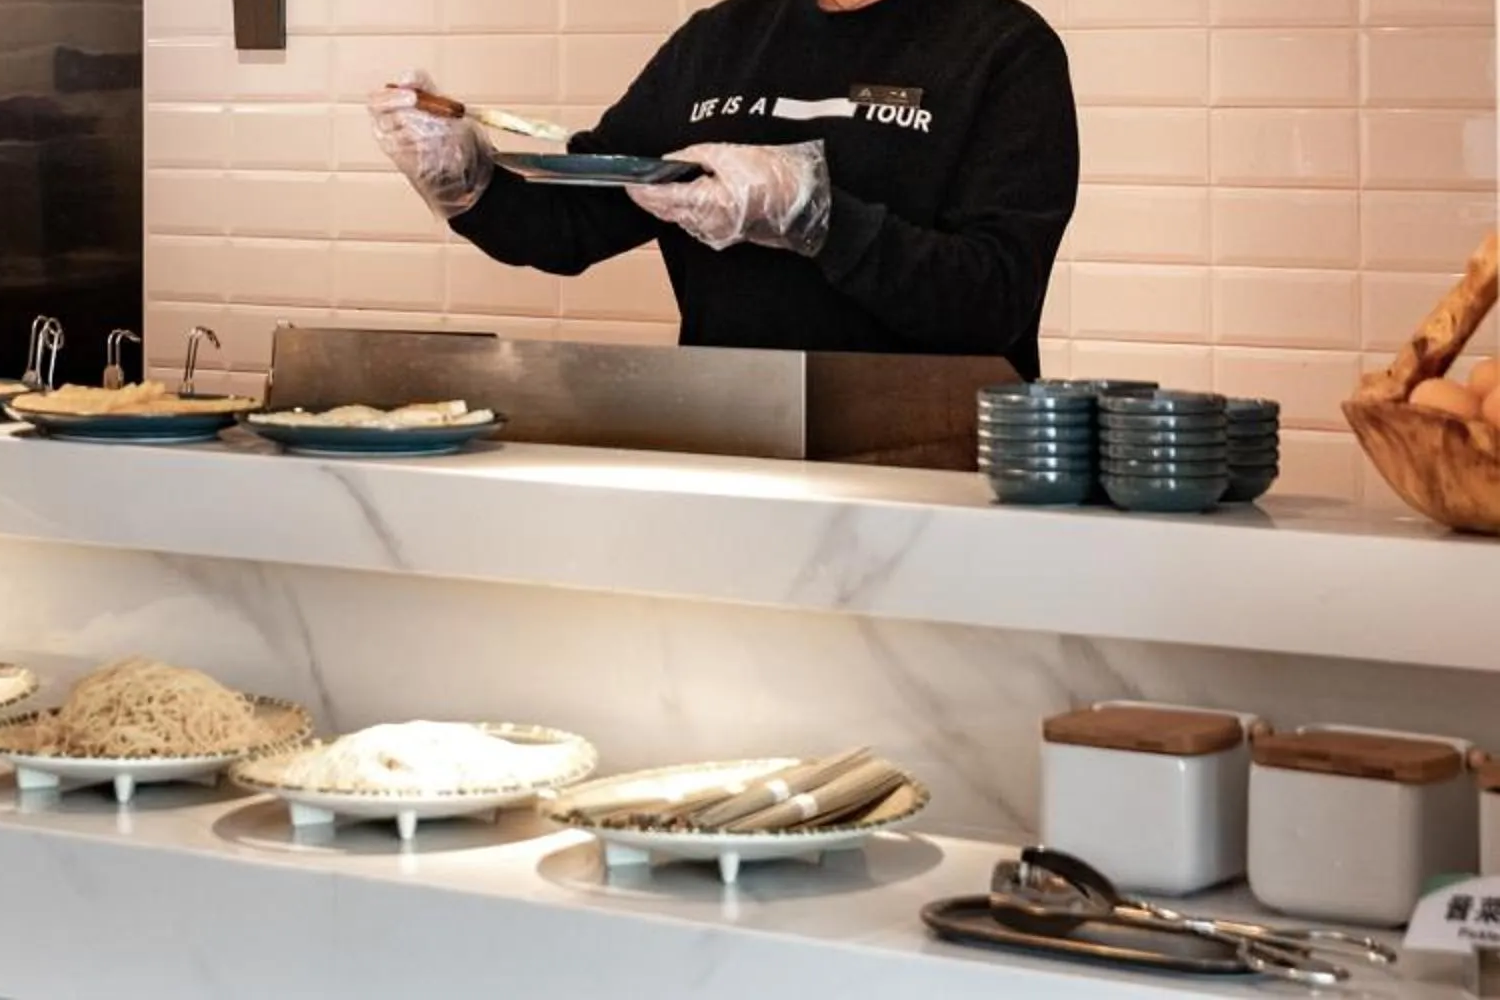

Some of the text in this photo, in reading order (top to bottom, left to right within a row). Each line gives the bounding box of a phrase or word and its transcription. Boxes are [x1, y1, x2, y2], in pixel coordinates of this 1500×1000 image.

[689, 95, 933, 134] LIFE IS A TOUR
